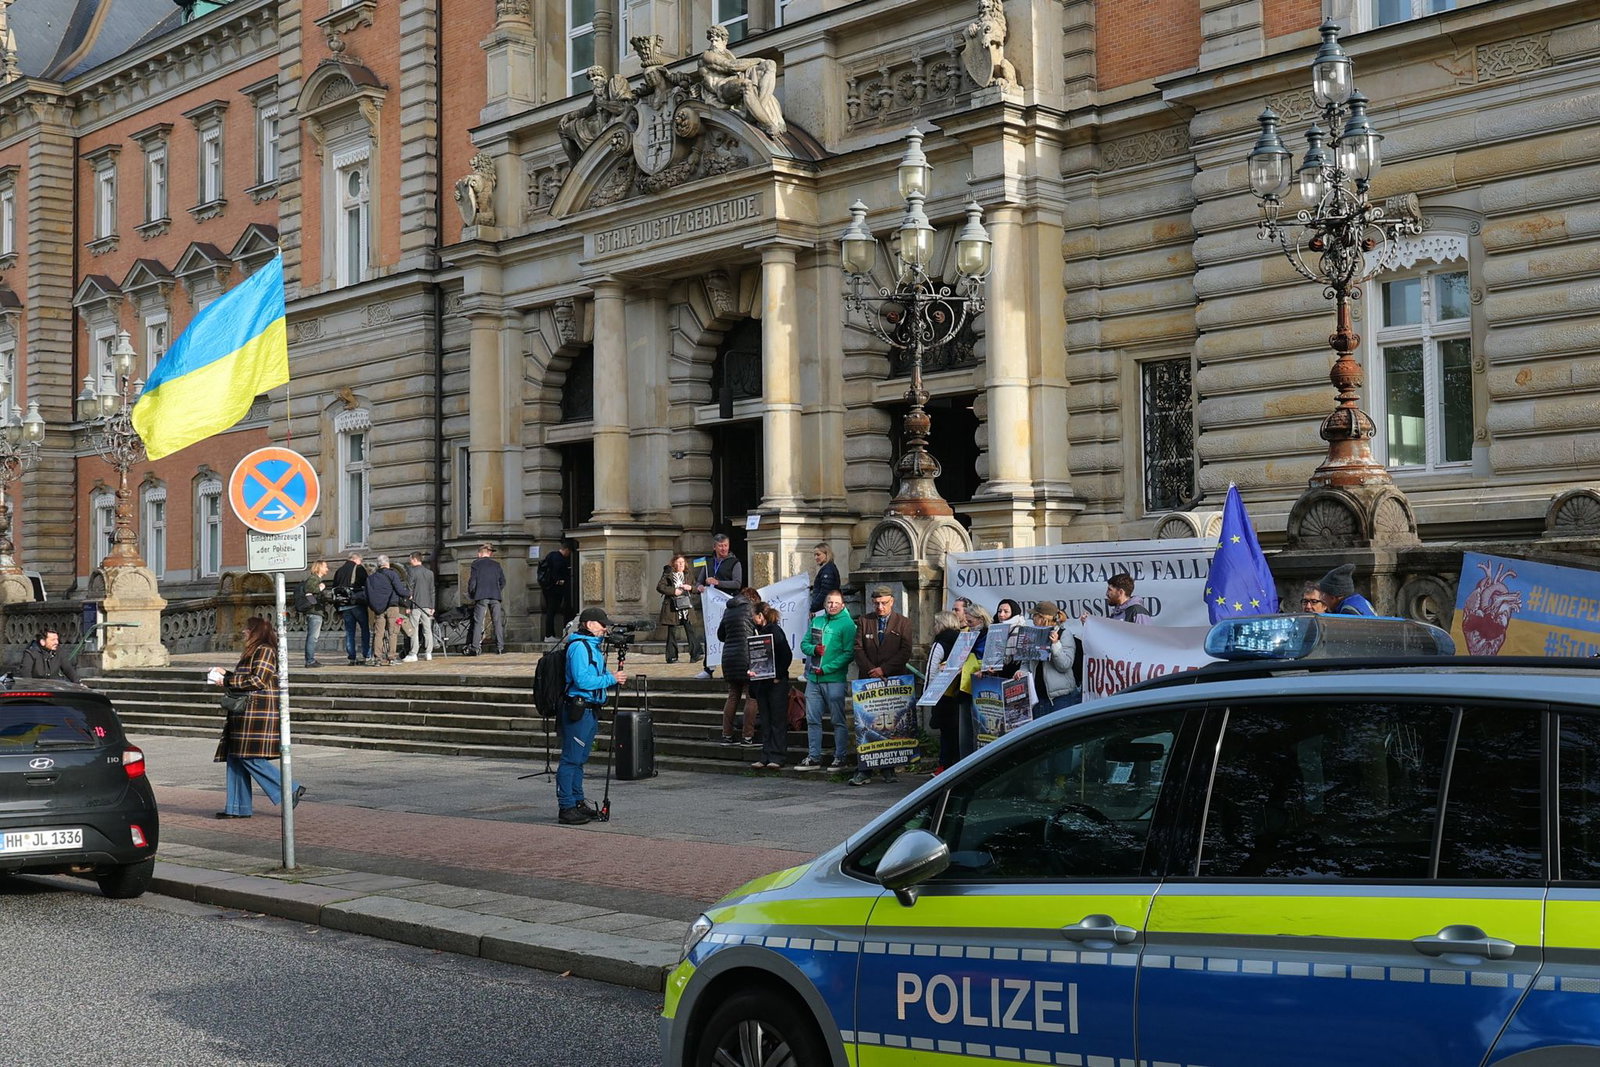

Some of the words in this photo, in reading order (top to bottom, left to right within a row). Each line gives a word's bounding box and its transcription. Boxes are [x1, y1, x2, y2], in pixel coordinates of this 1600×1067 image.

[956, 566, 1015, 588] SOLLTE
[1020, 565, 1048, 586] DIE
[1054, 561, 1145, 585] UKRAINE
[1528, 585, 1600, 621] #INDEPE
[865, 680, 885, 690] WHAT
[1088, 657, 1142, 696] RUSSIA
[856, 690, 876, 701] WAR
[877, 686, 912, 697] CRIMES?
[860, 751, 898, 761] SOLIDARITY
[898, 749, 914, 757] WITH
[865, 759, 879, 767] THE
[880, 756, 908, 765] ACCUSED
[6, 834, 22, 848] HH
[32, 833, 48, 846] JL
[52, 831, 81, 845] 1336
[897, 972, 1079, 1034] POLIZEI
